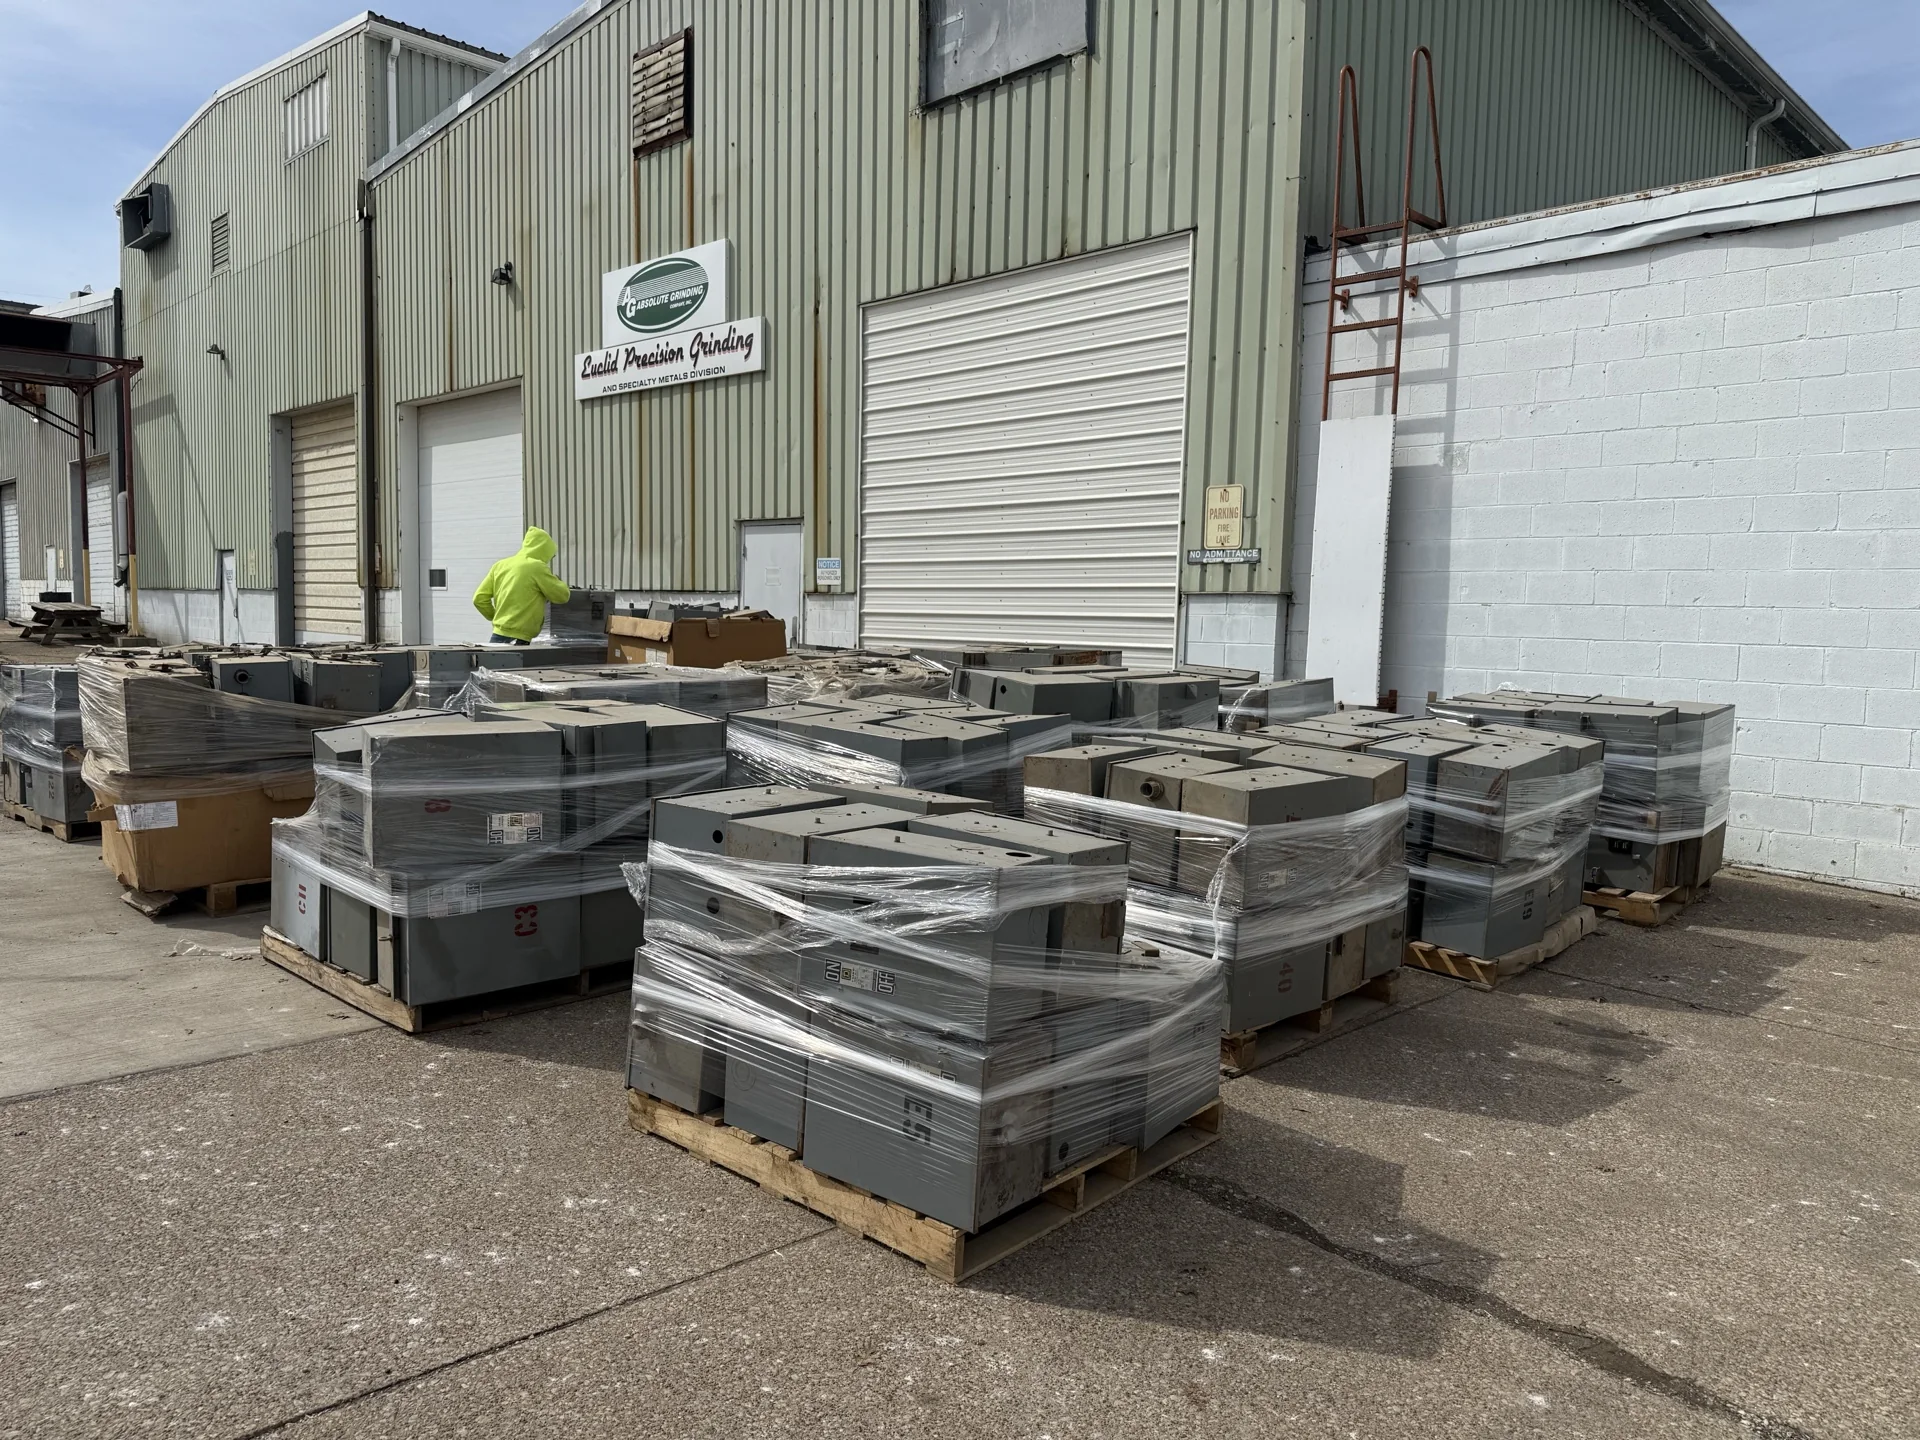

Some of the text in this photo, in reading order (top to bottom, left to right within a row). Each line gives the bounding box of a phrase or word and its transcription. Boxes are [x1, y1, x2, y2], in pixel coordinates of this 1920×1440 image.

[636, 285, 704, 310] ABSOLUTE GRINDING
[581, 325, 754, 380] Euclid Precision Grinding
[602, 366, 726, 393] AND SPECIALTY METALS DIVISION
[1219, 490, 1230, 503] NO
[1209, 506, 1239, 520] PARKING
[1217, 524, 1230, 532] FIRE
[1215, 535, 1231, 543] LANE
[1190, 549, 1259, 559] NO ADMITTANCE
[818, 560, 840, 568] NOTICE
[490, 830, 503, 845] OFF
[527, 829, 541, 842] ON
[514, 904, 538, 937] C3
[825, 961, 841, 982] ON
[1278, 962, 1294, 993] 40
[878, 971, 895, 994] OFF
[903, 1094, 933, 1146] E5
